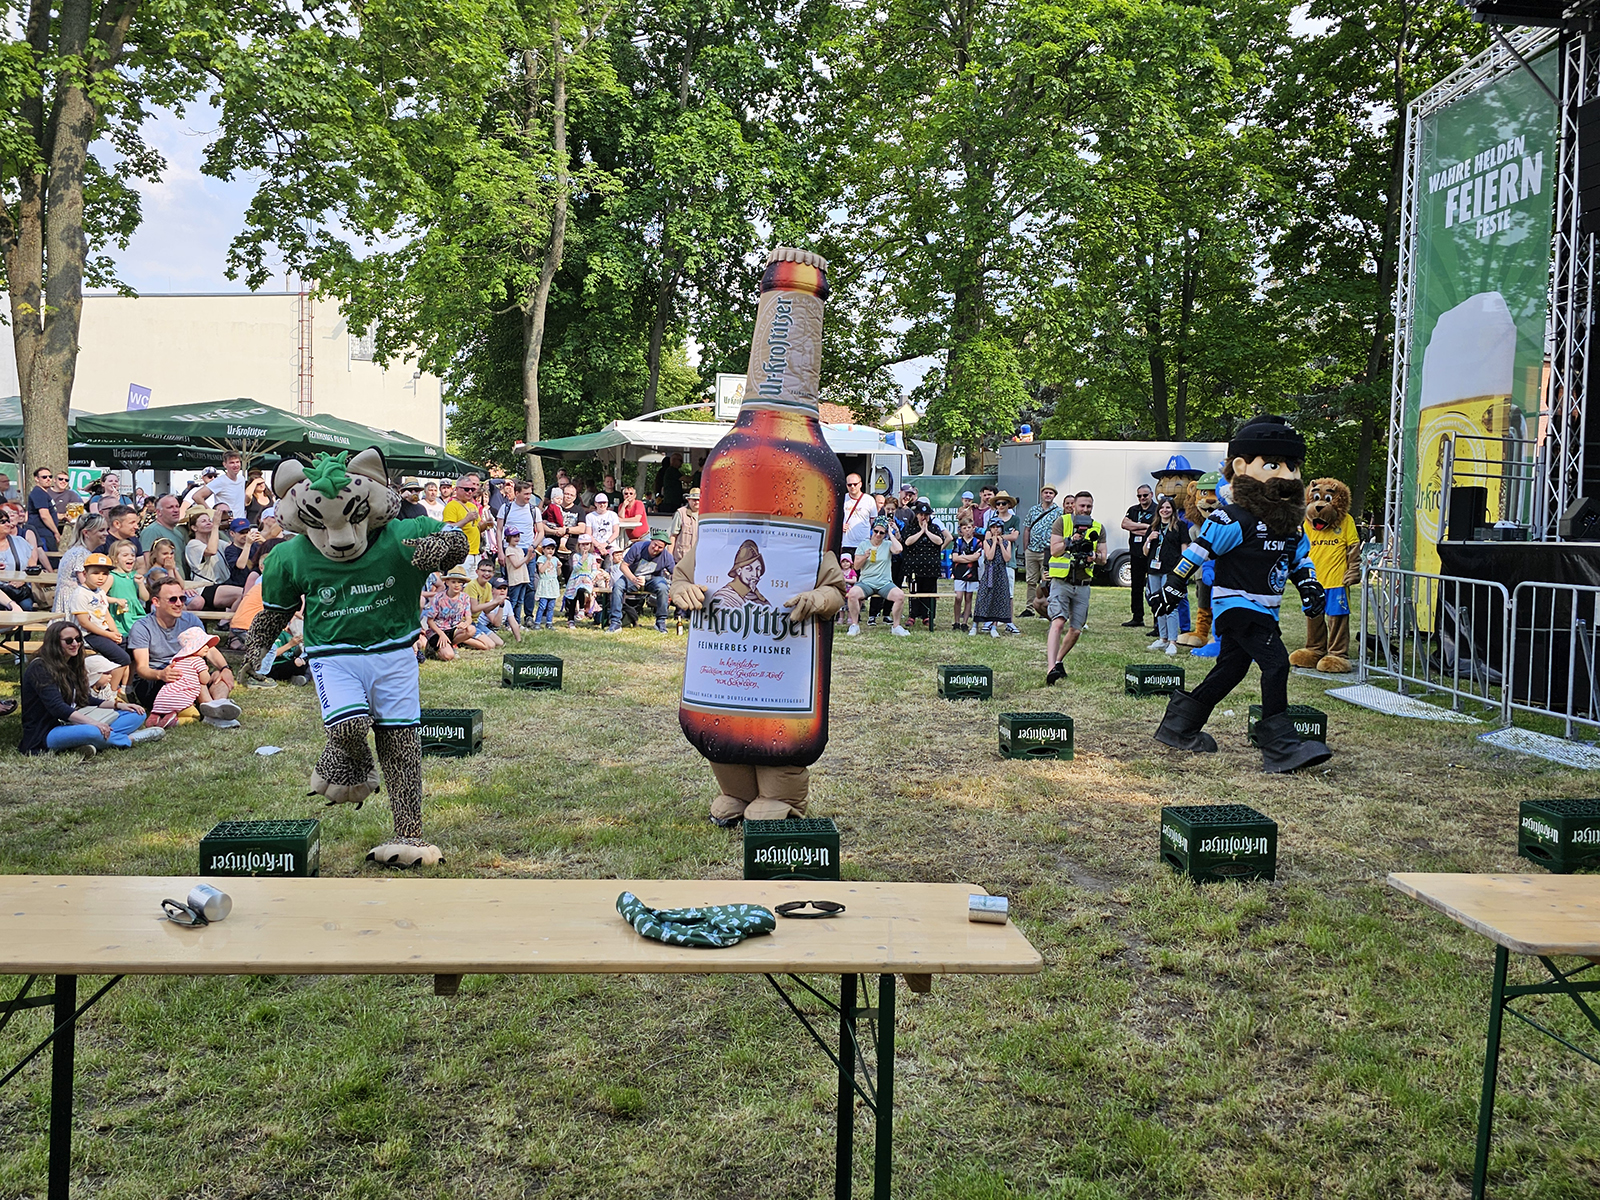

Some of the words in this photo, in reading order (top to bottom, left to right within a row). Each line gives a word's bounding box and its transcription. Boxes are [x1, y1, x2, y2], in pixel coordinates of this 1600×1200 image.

[1429, 158, 1471, 194] WAHRE
[1474, 134, 1525, 174] HELDEN
[1445, 151, 1542, 228] FEIERN
[1476, 209, 1511, 239] FESTE
[129, 391, 150, 407] WC
[730, 528, 775, 536] BRAUHANDWERK
[1263, 541, 1286, 551] KSW
[705, 575, 719, 584] SEIT
[771, 579, 789, 588] 1534
[350, 582, 385, 596] Allianz
[698, 640, 748, 653] FEINHERBES
[753, 645, 792, 655] PILSNER
[317, 674, 330, 709] Allianz
